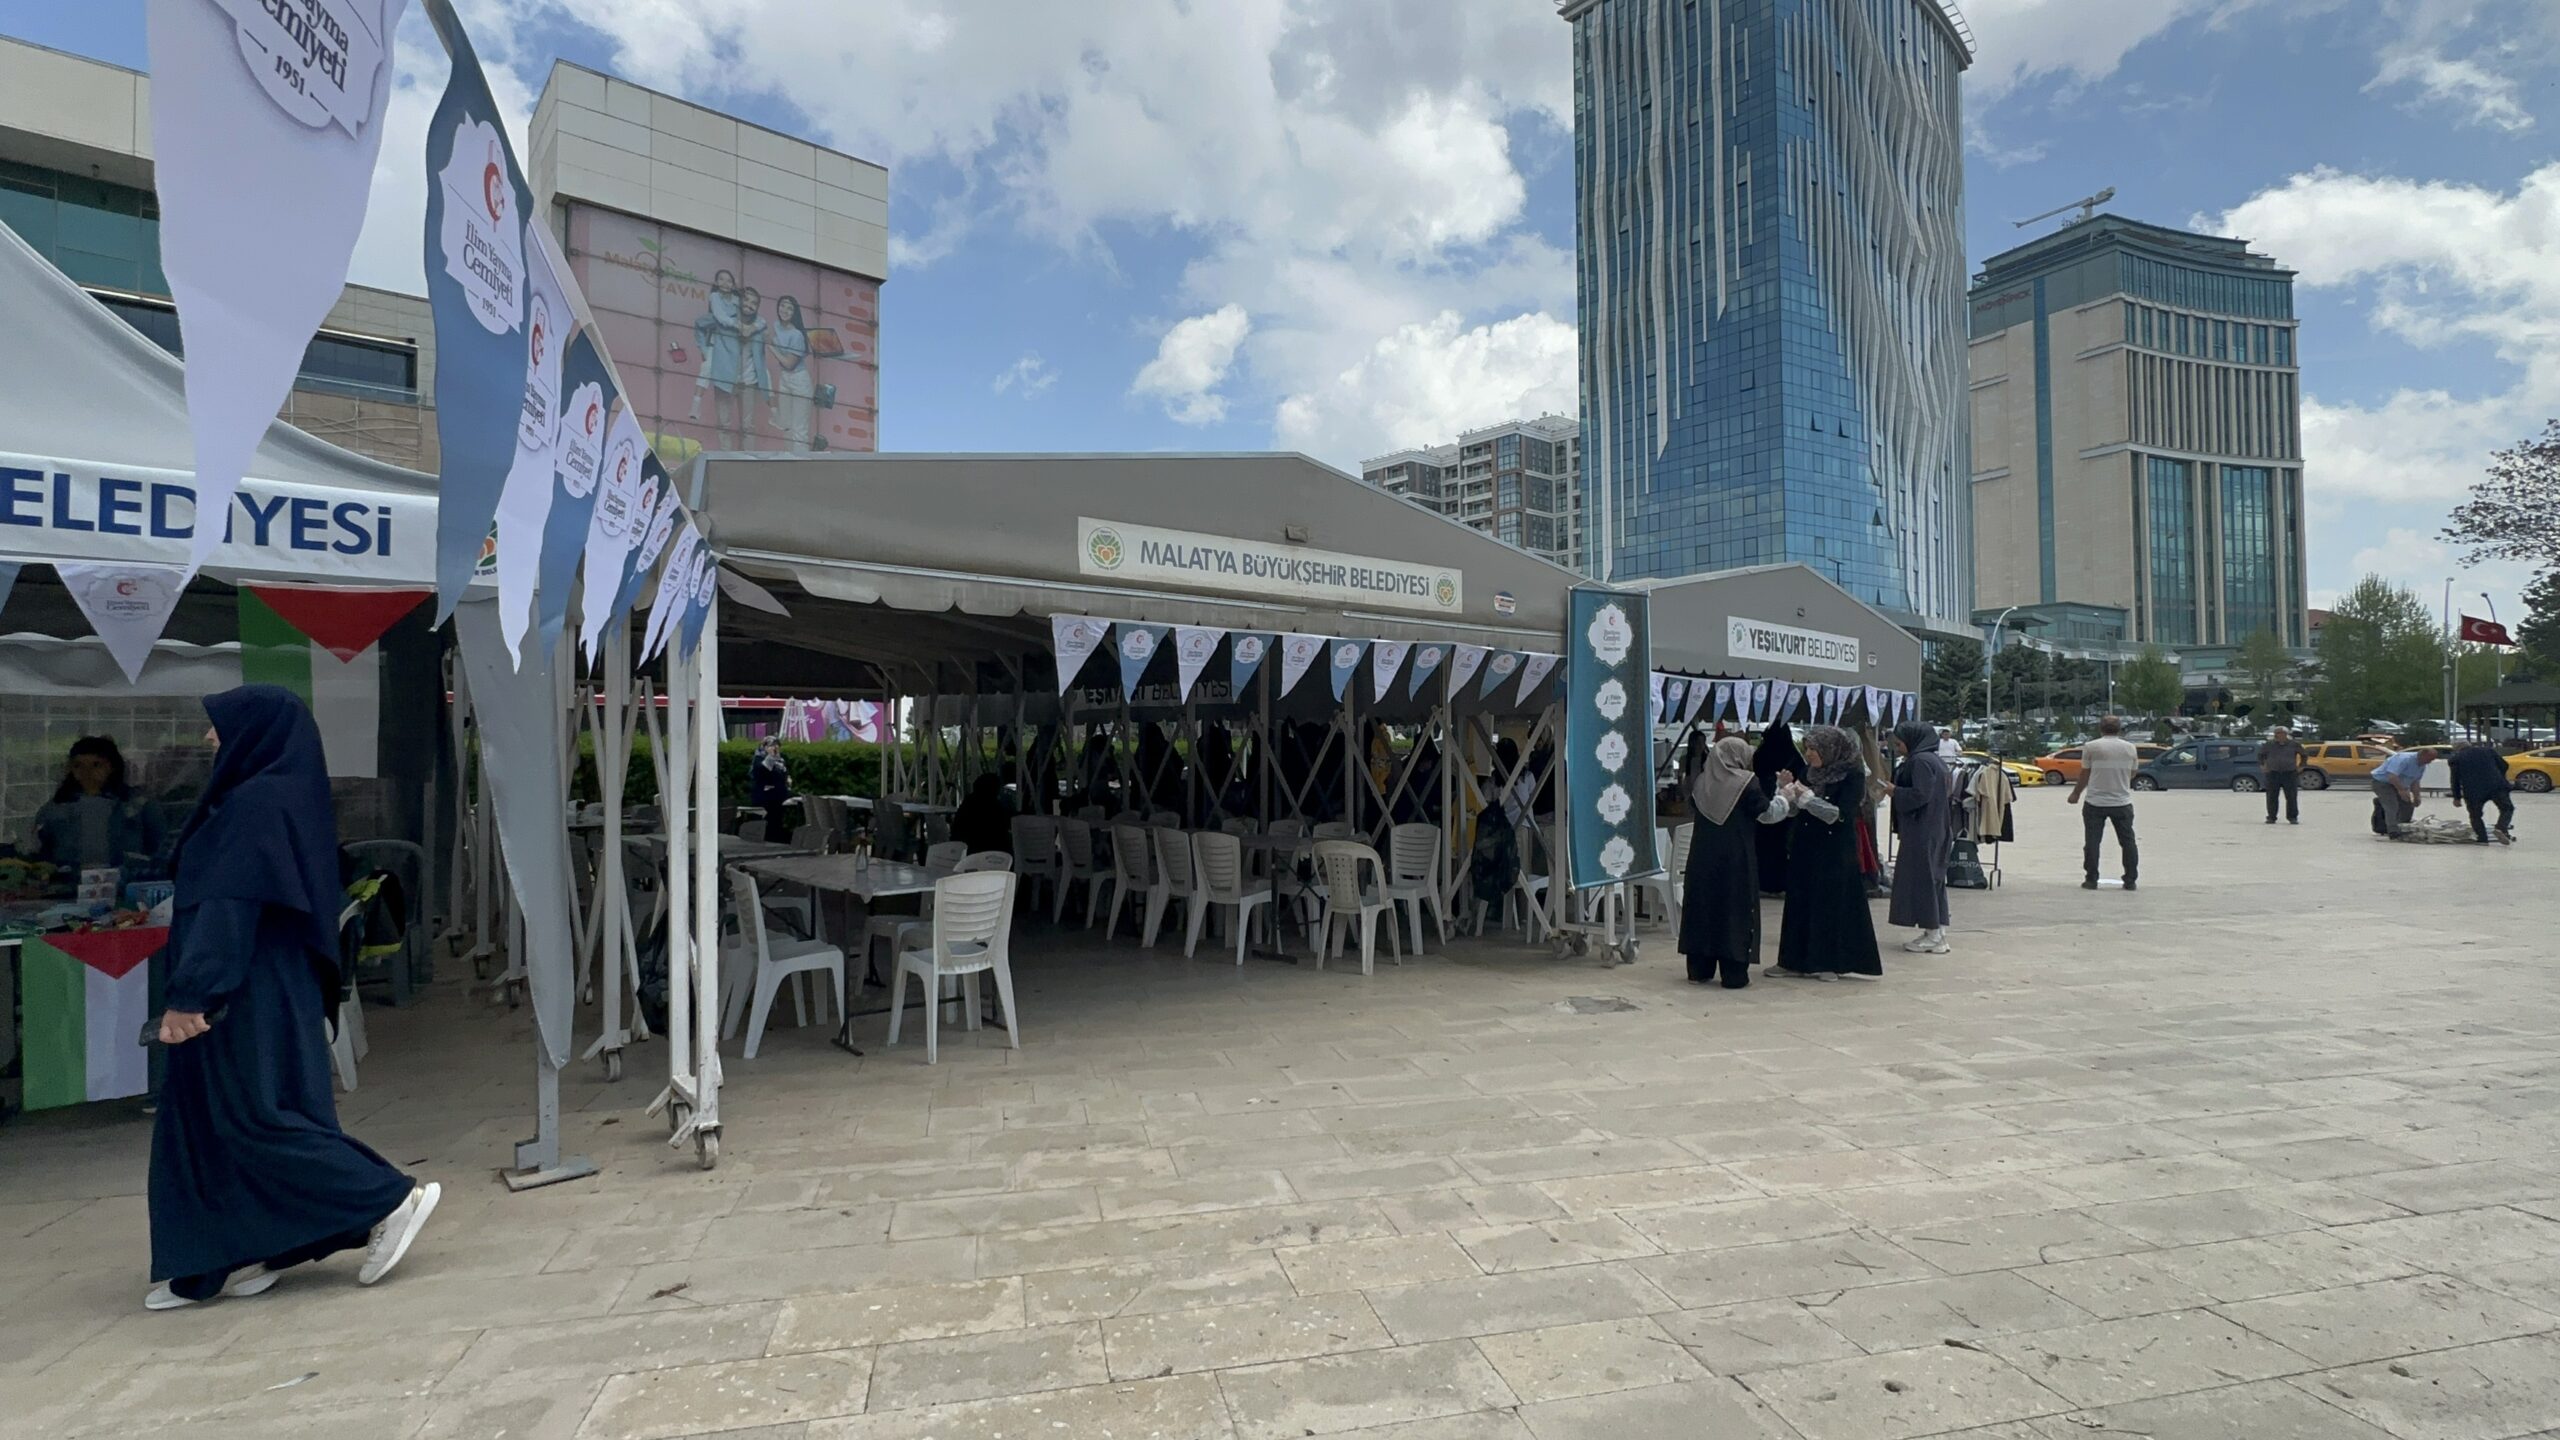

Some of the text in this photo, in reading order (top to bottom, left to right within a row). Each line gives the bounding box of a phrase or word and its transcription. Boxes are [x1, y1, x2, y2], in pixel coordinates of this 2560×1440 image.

[258, 0, 347, 94] emiyeti
[300, 0, 349, 57] ayma
[274, 55, 306, 96] 1951
[463, 243, 513, 308] Cemiyeti
[487, 242, 513, 284] Yayma
[666, 283, 706, 301] AVM
[1140, 540, 1238, 574] MALATYA
[1243, 553, 1347, 587] BÜYÜKŞEHİR
[1350, 567, 1430, 597] BELEDİYESİ
[1749, 628, 1807, 656] YEŞİLYURT
[1808, 637, 1857, 664] BELEDİYESİ
